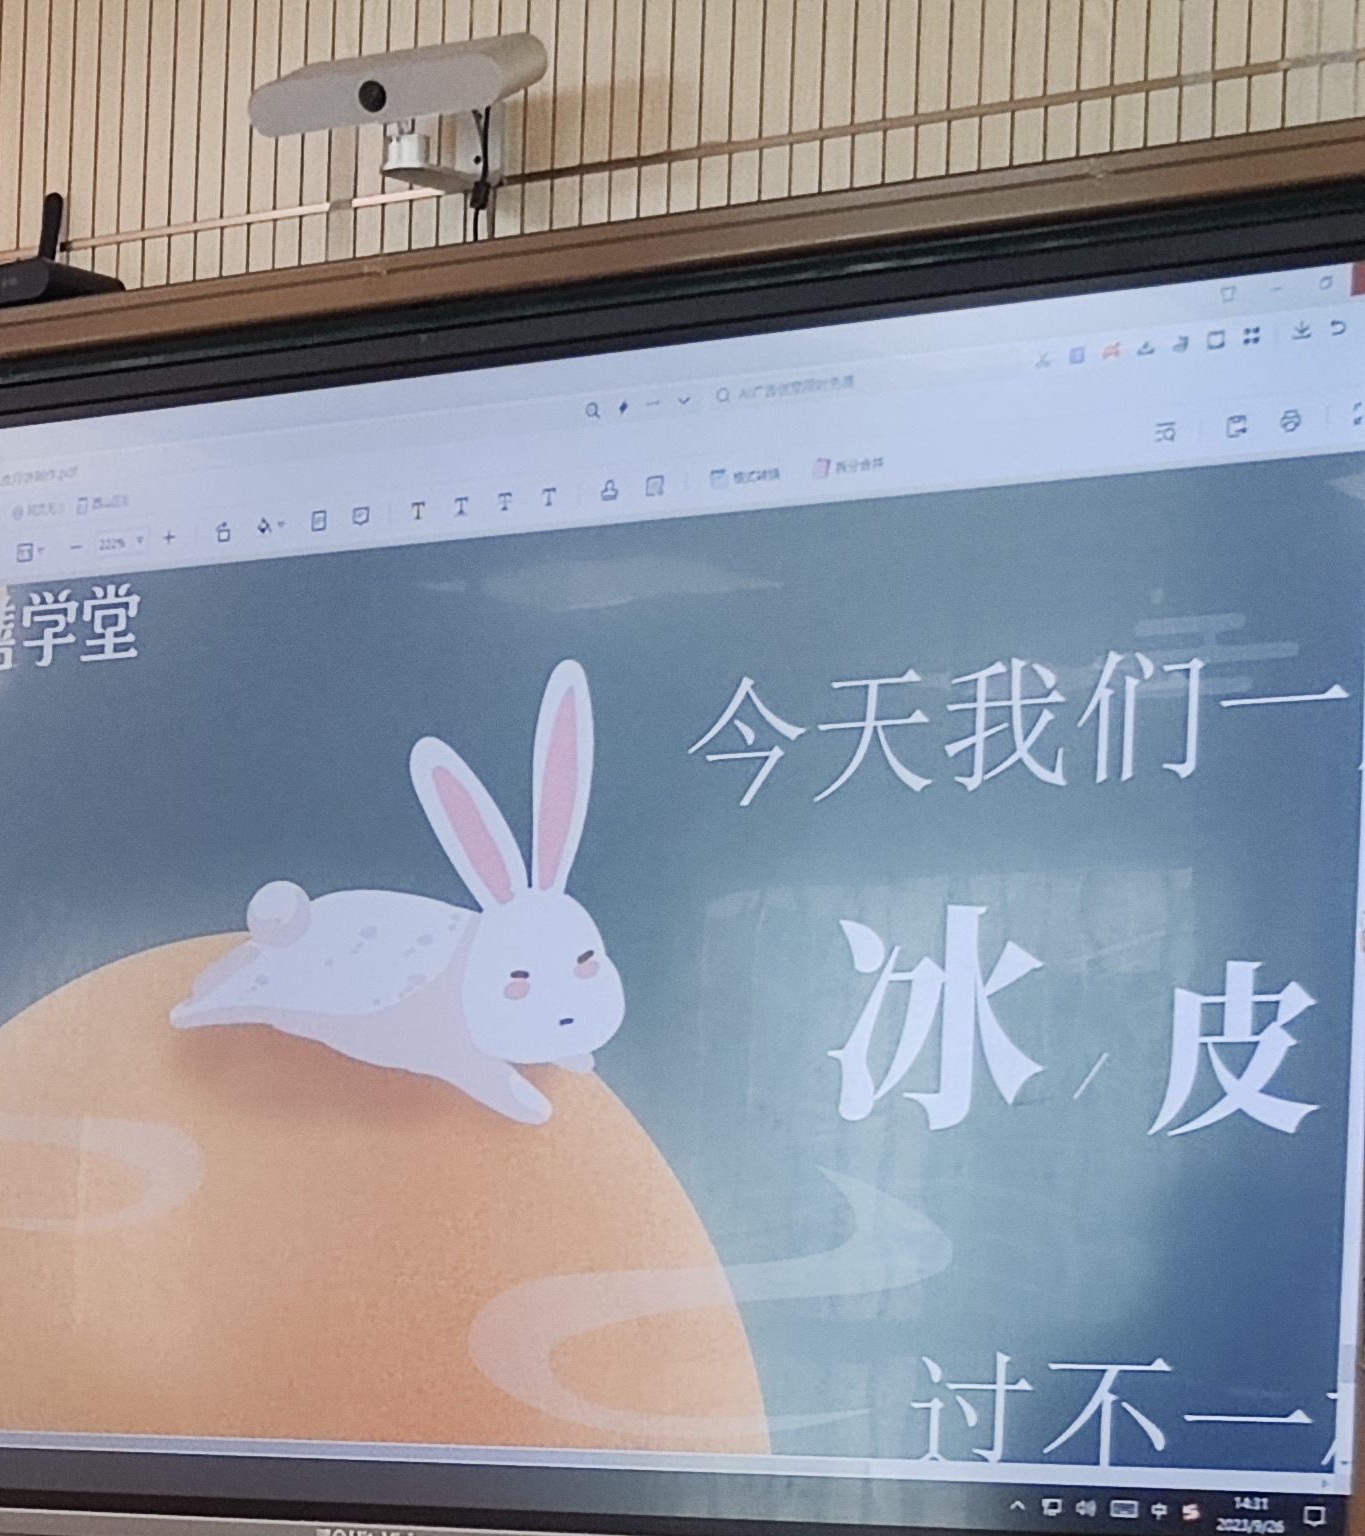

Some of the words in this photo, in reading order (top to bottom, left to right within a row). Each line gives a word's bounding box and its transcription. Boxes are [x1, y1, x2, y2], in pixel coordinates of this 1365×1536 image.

[688, 650, 1349, 807] 今天我们一
[910, 1352, 1337, 1472] 过不一
